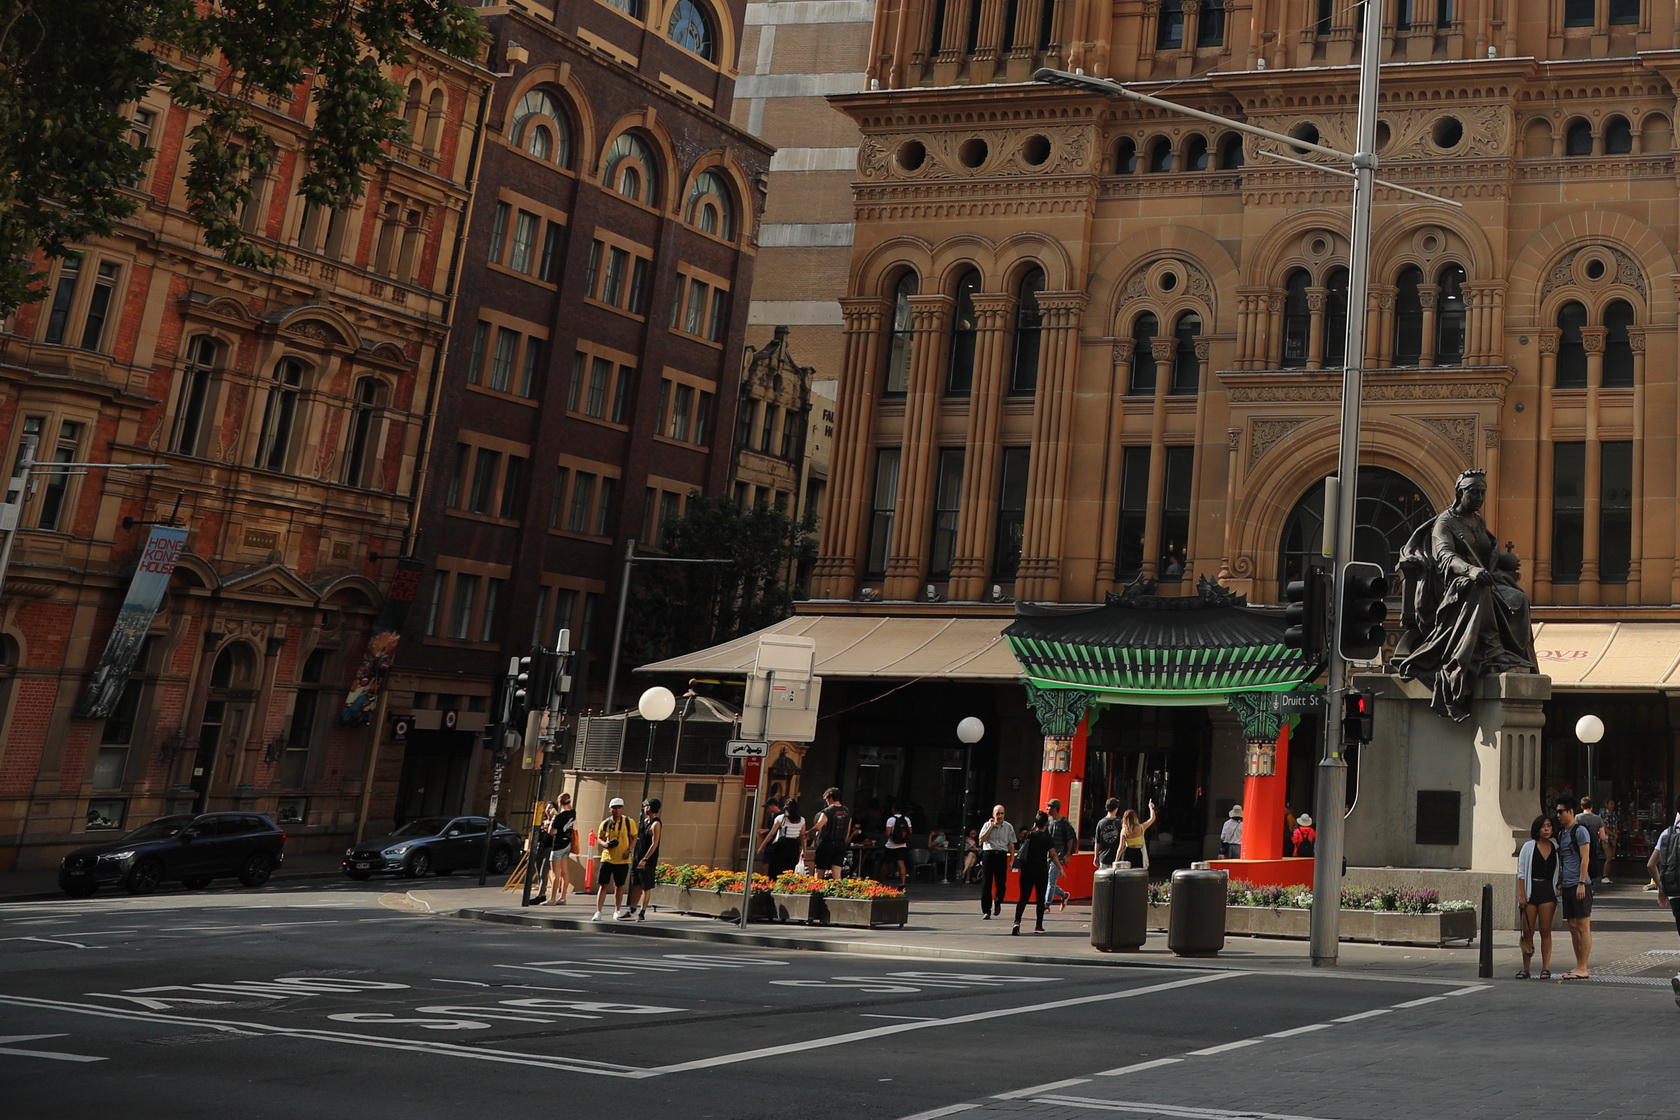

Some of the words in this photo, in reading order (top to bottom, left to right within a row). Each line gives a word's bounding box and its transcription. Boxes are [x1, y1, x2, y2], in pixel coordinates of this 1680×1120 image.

[147, 537, 185, 552] HONG
[143, 548, 180, 563] KONG
[139, 560, 176, 575] HOUSE
[1535, 649, 1589, 663] QVB
[1282, 694, 1306, 707] Druitt
[1310, 694, 1319, 706] St
